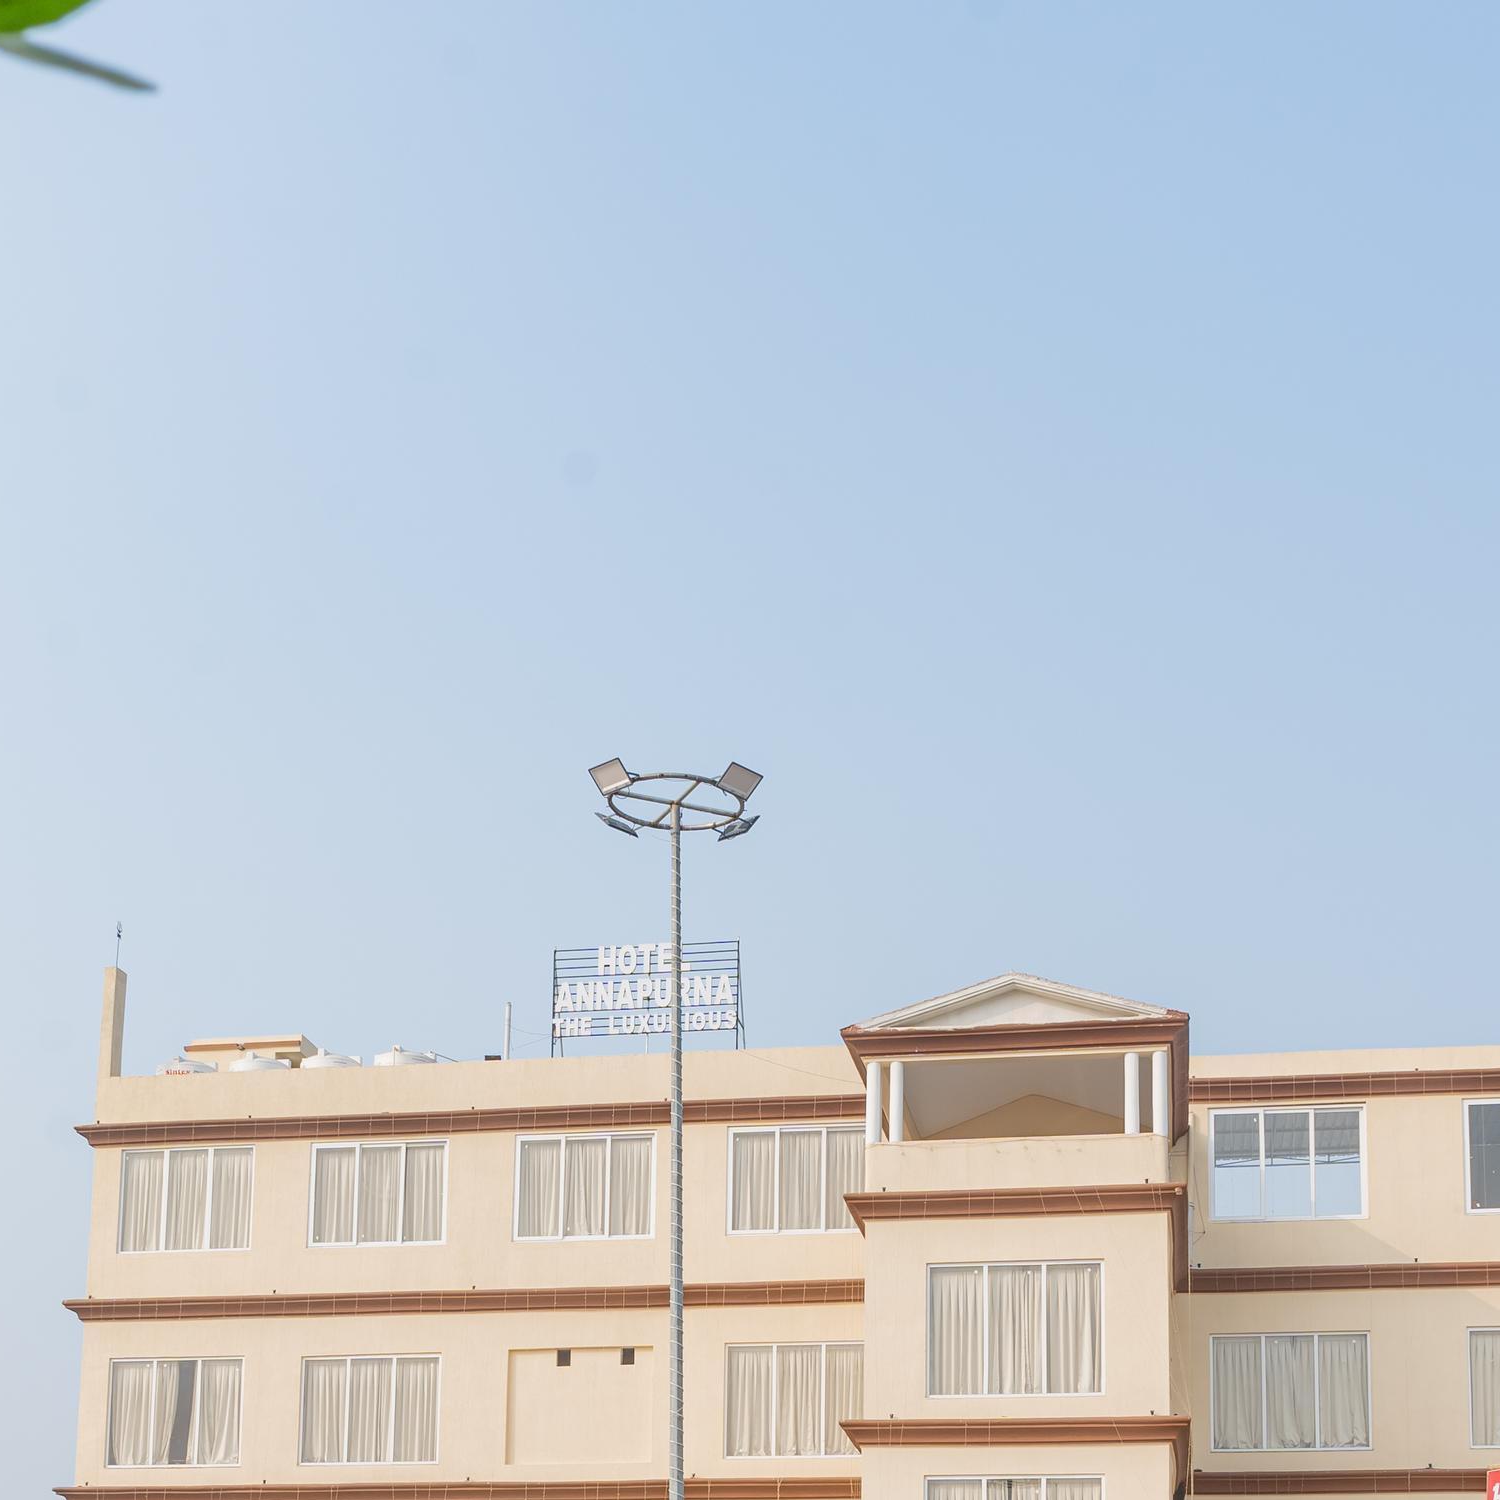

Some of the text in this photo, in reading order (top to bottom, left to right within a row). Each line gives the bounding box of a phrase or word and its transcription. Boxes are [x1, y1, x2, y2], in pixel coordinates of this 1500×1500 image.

[555, 974, 734, 1012] ANNAPURNA
[552, 1010, 738, 1037] THE LUXUIOUS
